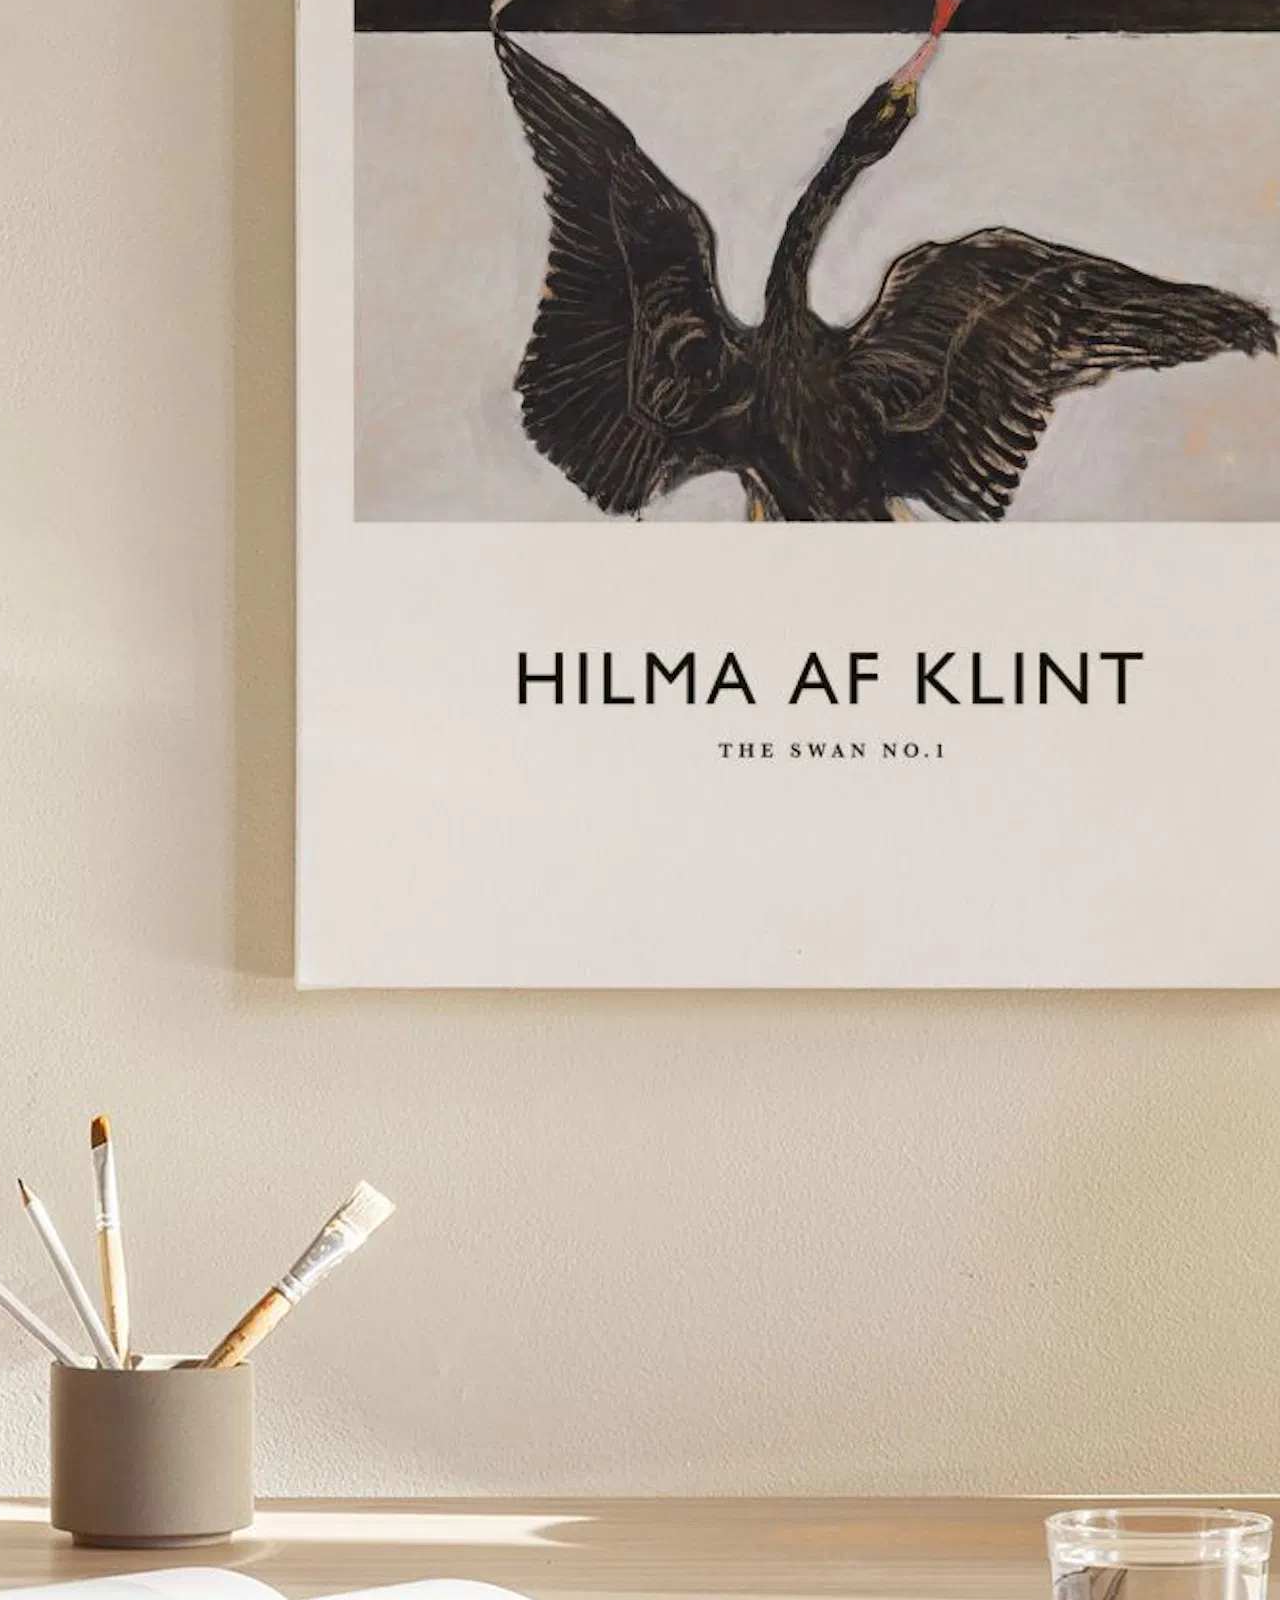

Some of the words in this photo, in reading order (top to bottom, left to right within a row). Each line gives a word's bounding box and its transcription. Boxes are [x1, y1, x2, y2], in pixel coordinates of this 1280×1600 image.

[517, 651, 757, 705] HILMA
[787, 651, 879, 705] AF
[916, 651, 1145, 705] KLINT
[717, 742, 774, 759] THE
[789, 742, 866, 759] SWAN
[882, 742, 944, 759] NO.1
